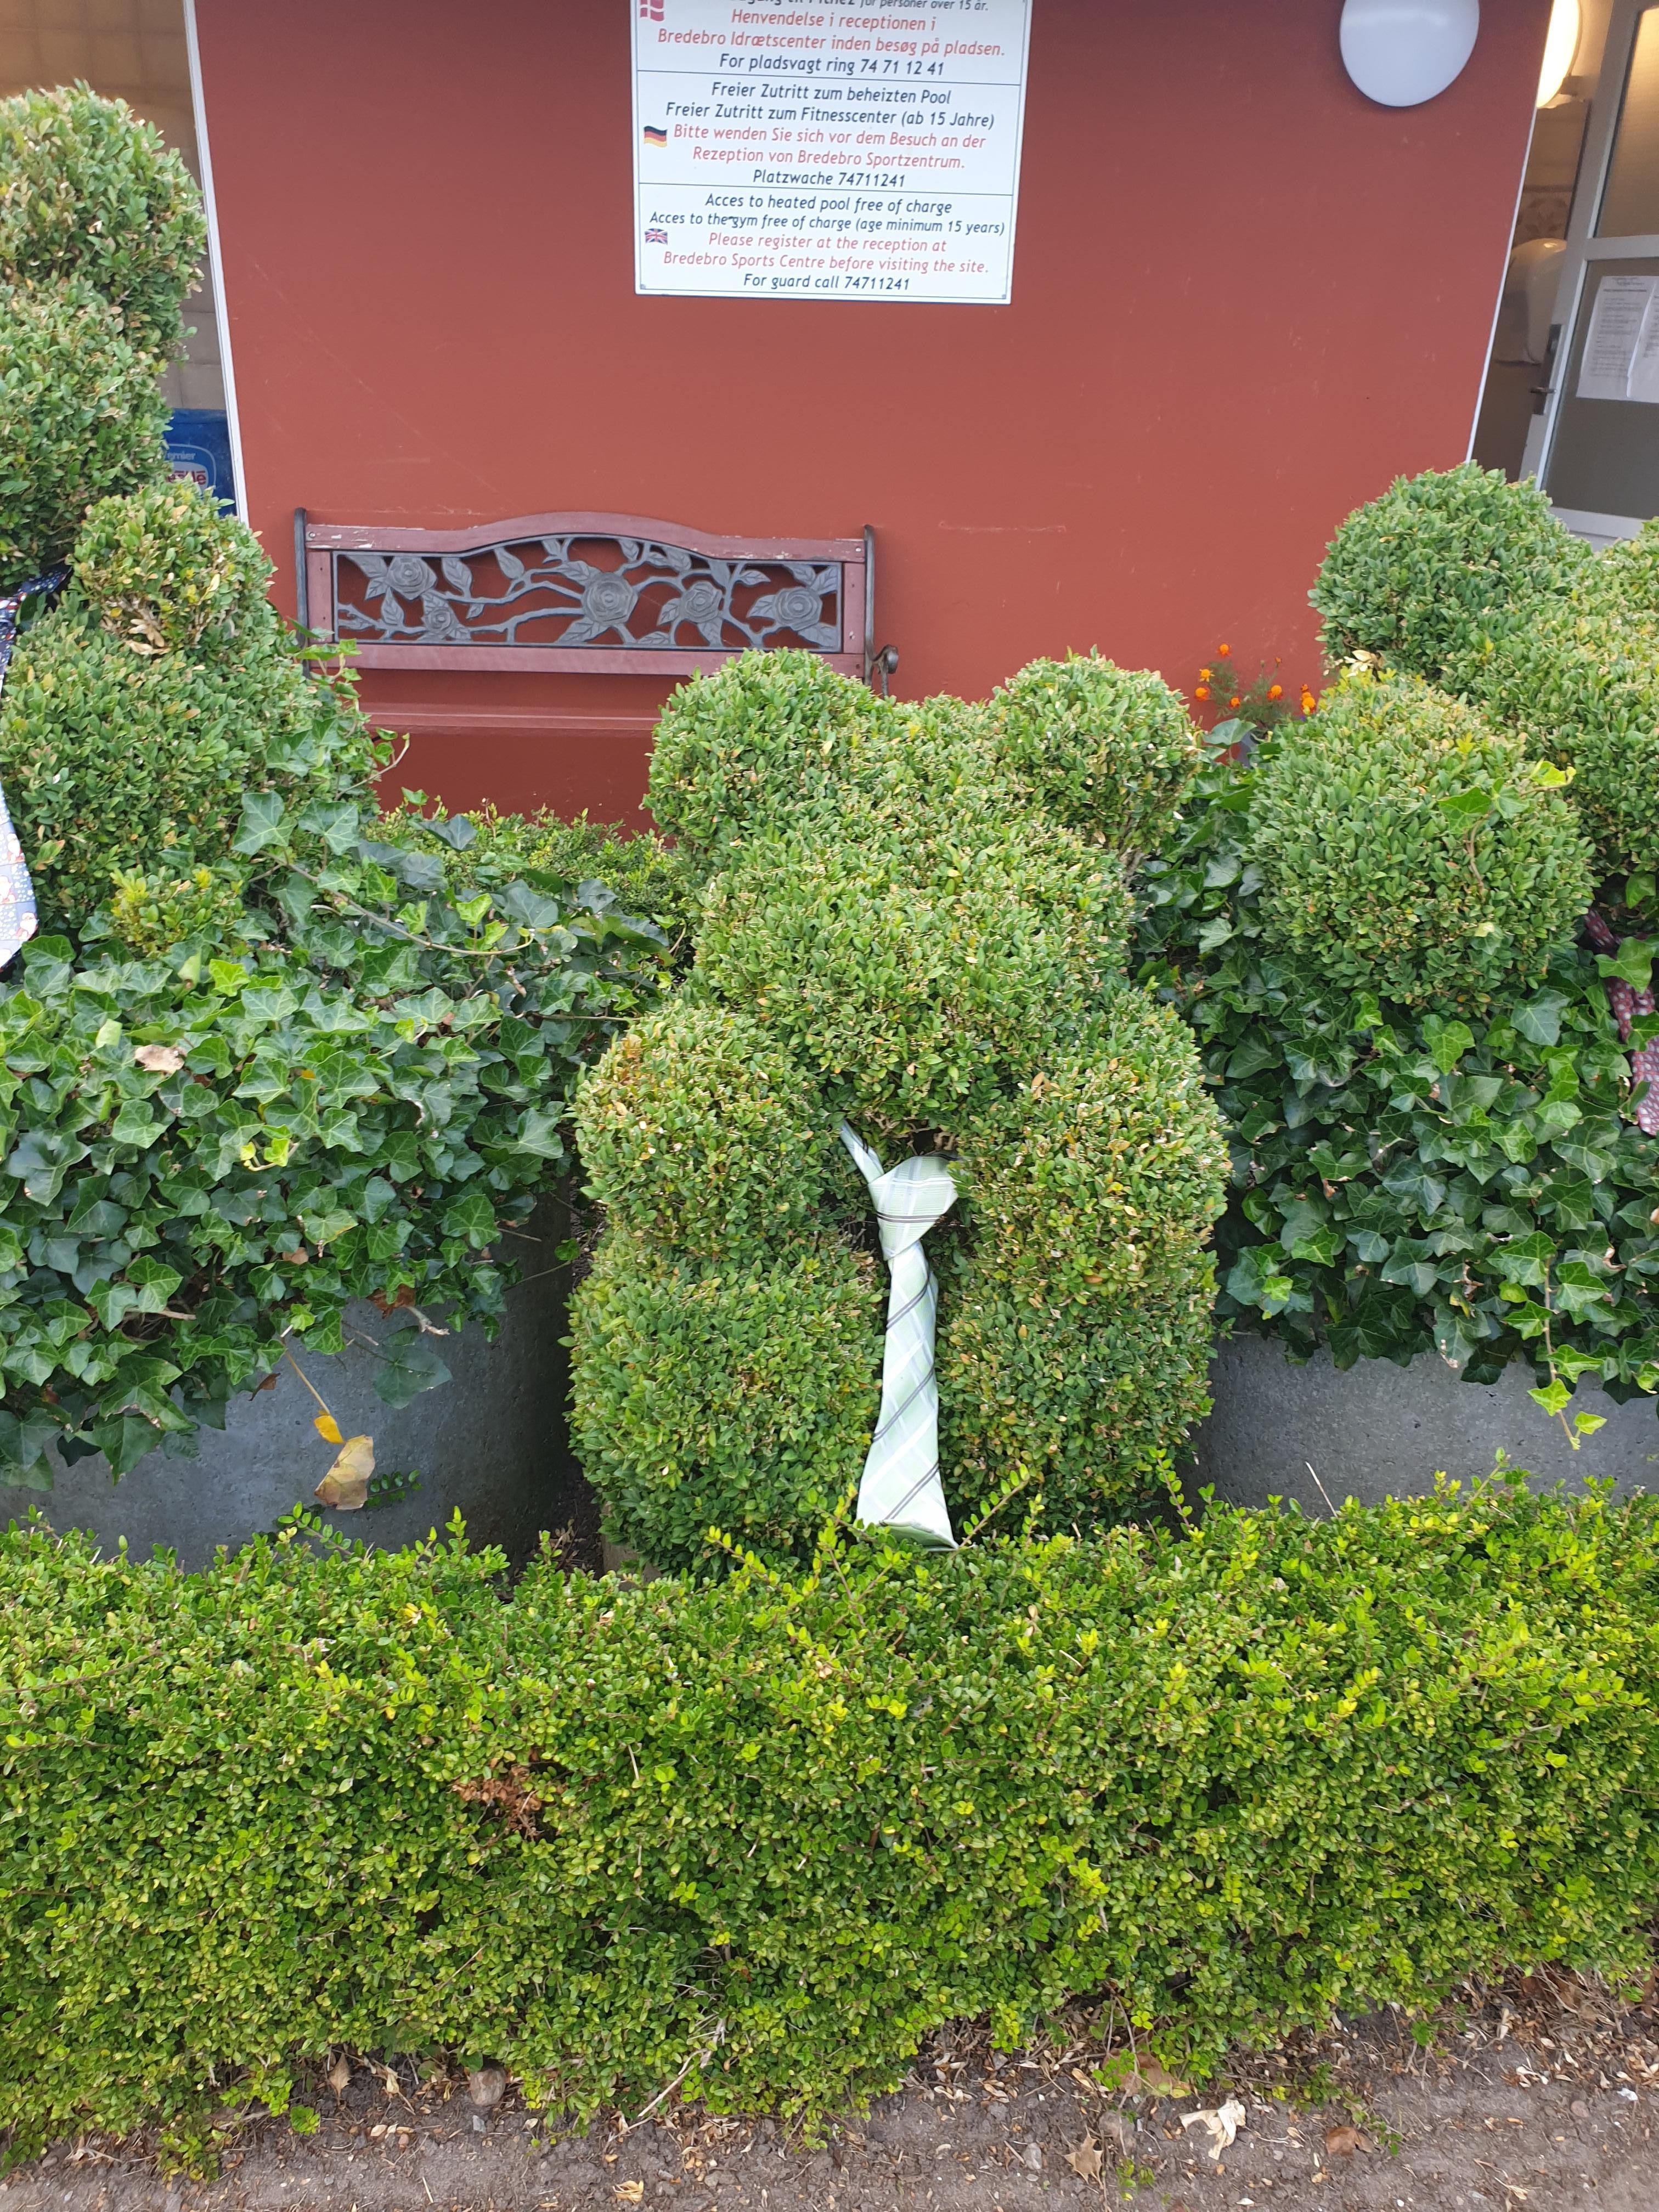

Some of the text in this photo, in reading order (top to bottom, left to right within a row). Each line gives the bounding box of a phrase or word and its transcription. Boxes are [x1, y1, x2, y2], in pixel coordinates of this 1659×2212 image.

[879, 0, 928, 9] personer
[930, 1, 956, 9] over
[960, 0, 972, 10] 15
[731, 9, 936, 32] Henvendelse i receptionen i
[658, 28, 1005, 57] Bredebro Idrætscenter inden besøg på pladsen.
[720, 53, 944, 76] For pladsvagt ring 74 71 12 41
[712, 82, 951, 104] Freier Zutritt zum beheizten Pool
[666, 101, 994, 131] Freier Zutritt zum Fitnesscenter (ab 15 Jahre)
[674, 123, 986, 148] Bitte wenden Sie sich vor dem Besuch an der
[693, 146, 964, 169] Rezeption von Bredebro Sportzentrum.
[753, 169, 905, 187] Platzwache 74711241
[705, 193, 952, 216] Acces to heated pool free of charge
[650, 211, 685, 224] Acces
[690, 213, 703, 224] to
[761, 215, 788, 229] free
[792, 216, 806, 230] of
[809, 216, 851, 232] charge
[856, 218, 882, 233] (age
[886, 218, 943, 232] minimum
[949, 221, 962, 232] 15
[965, 222, 1005, 236] years)
[709, 233, 946, 253] Please register at the reception at
[664, 251, 988, 274] Bredebro Sports Centre before visiting the site.
[744, 274, 910, 290] For guard call 74711241
